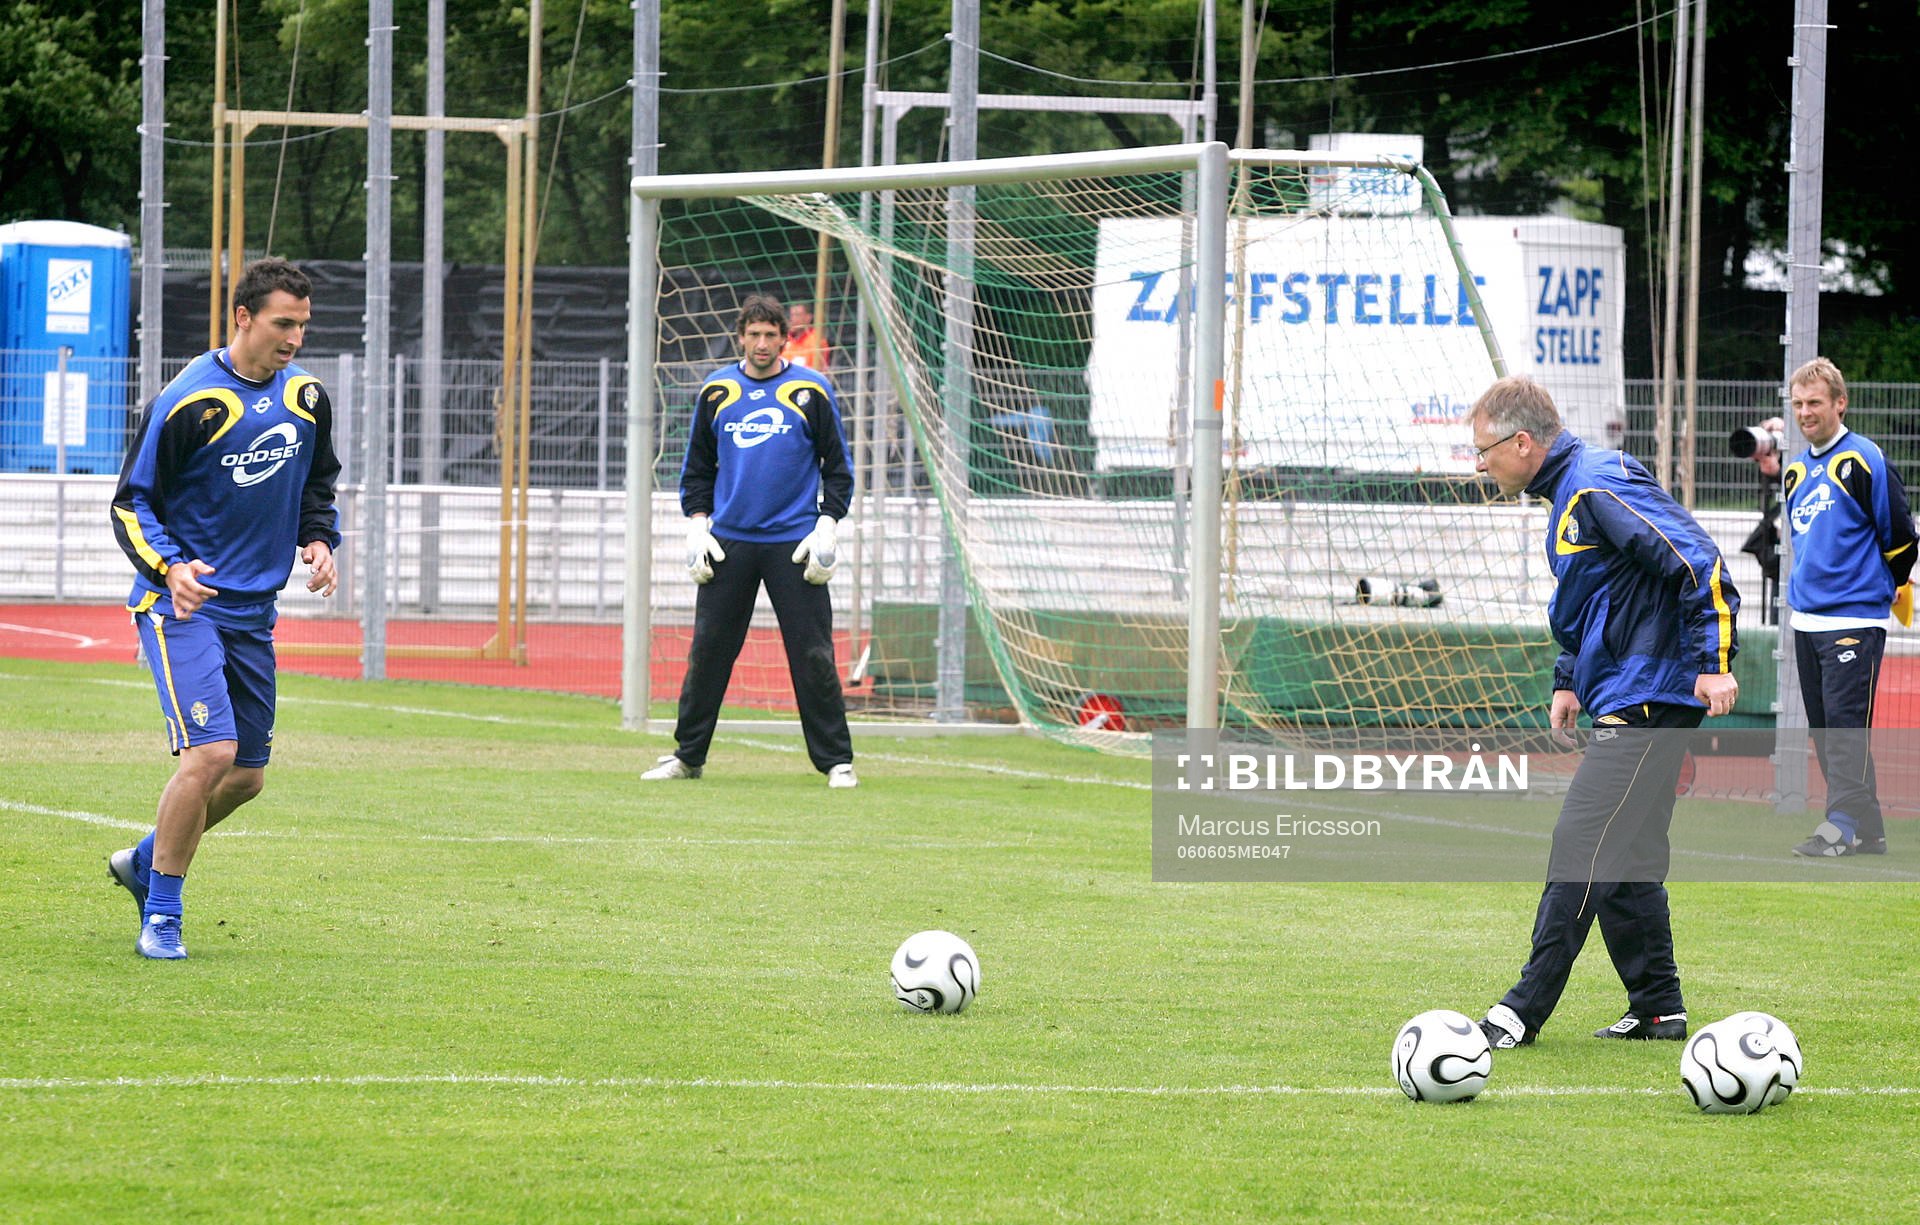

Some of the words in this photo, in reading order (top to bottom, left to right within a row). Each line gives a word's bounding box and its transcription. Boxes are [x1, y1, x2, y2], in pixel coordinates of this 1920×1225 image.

[1126, 271, 1486, 327] ZFSTELLE
[1537, 266, 1603, 317] ZAPF
[1535, 326, 1601, 365] STELLE
[724, 422, 792, 435] ODDSET
[220, 440, 303, 467] ODDSET
